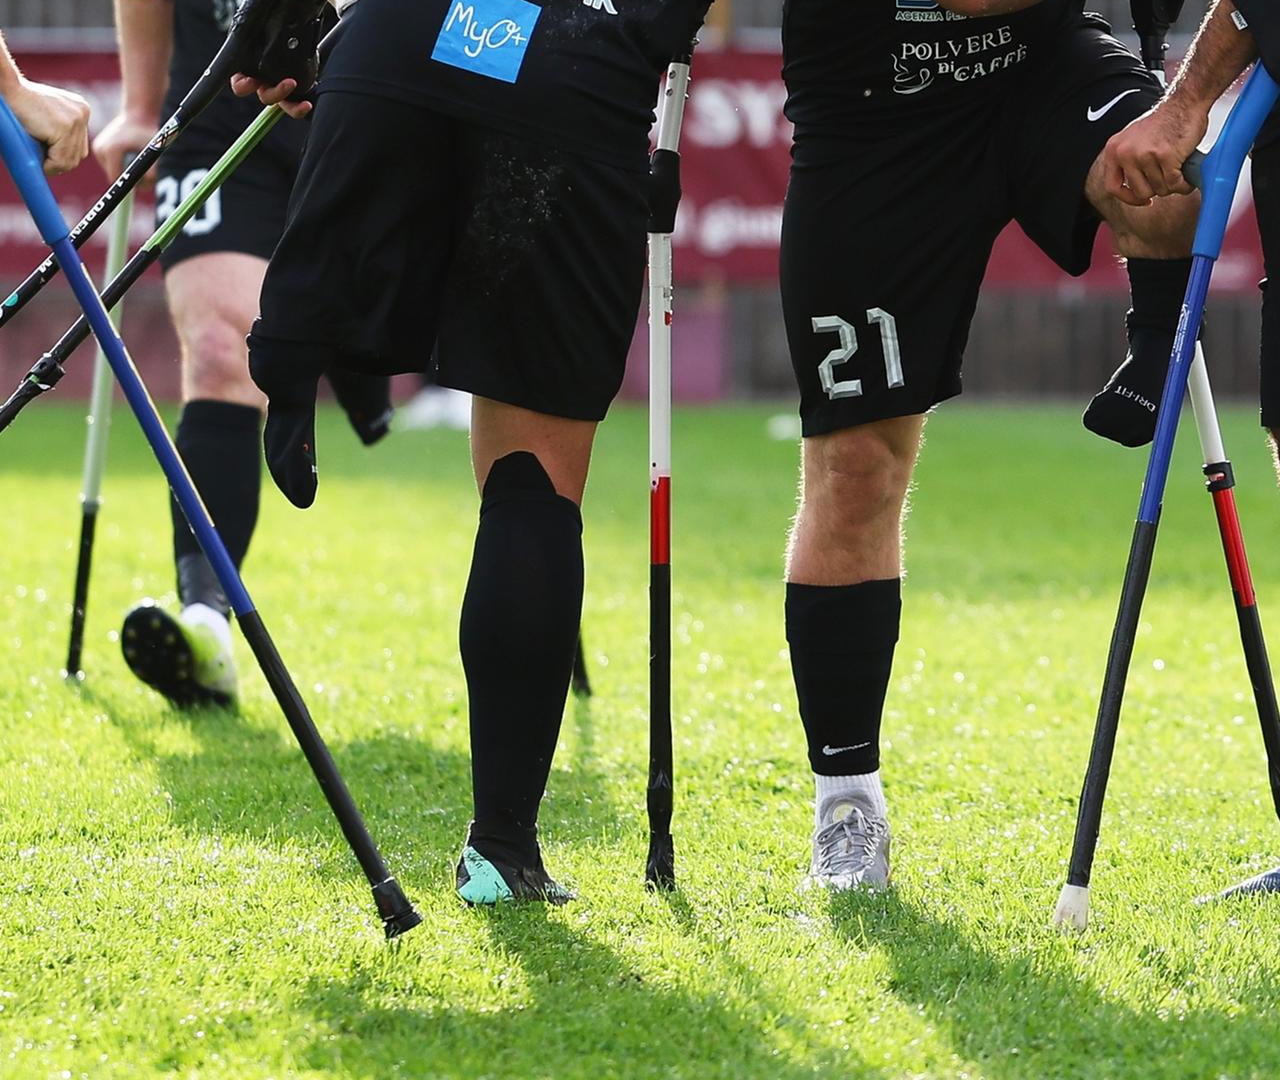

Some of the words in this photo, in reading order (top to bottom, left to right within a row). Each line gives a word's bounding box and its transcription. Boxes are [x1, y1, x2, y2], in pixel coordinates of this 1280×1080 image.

[895, 10, 944, 22] AGENZIA
[901, 25, 1013, 60] POLVERE
[811, 306, 905, 400] 21
